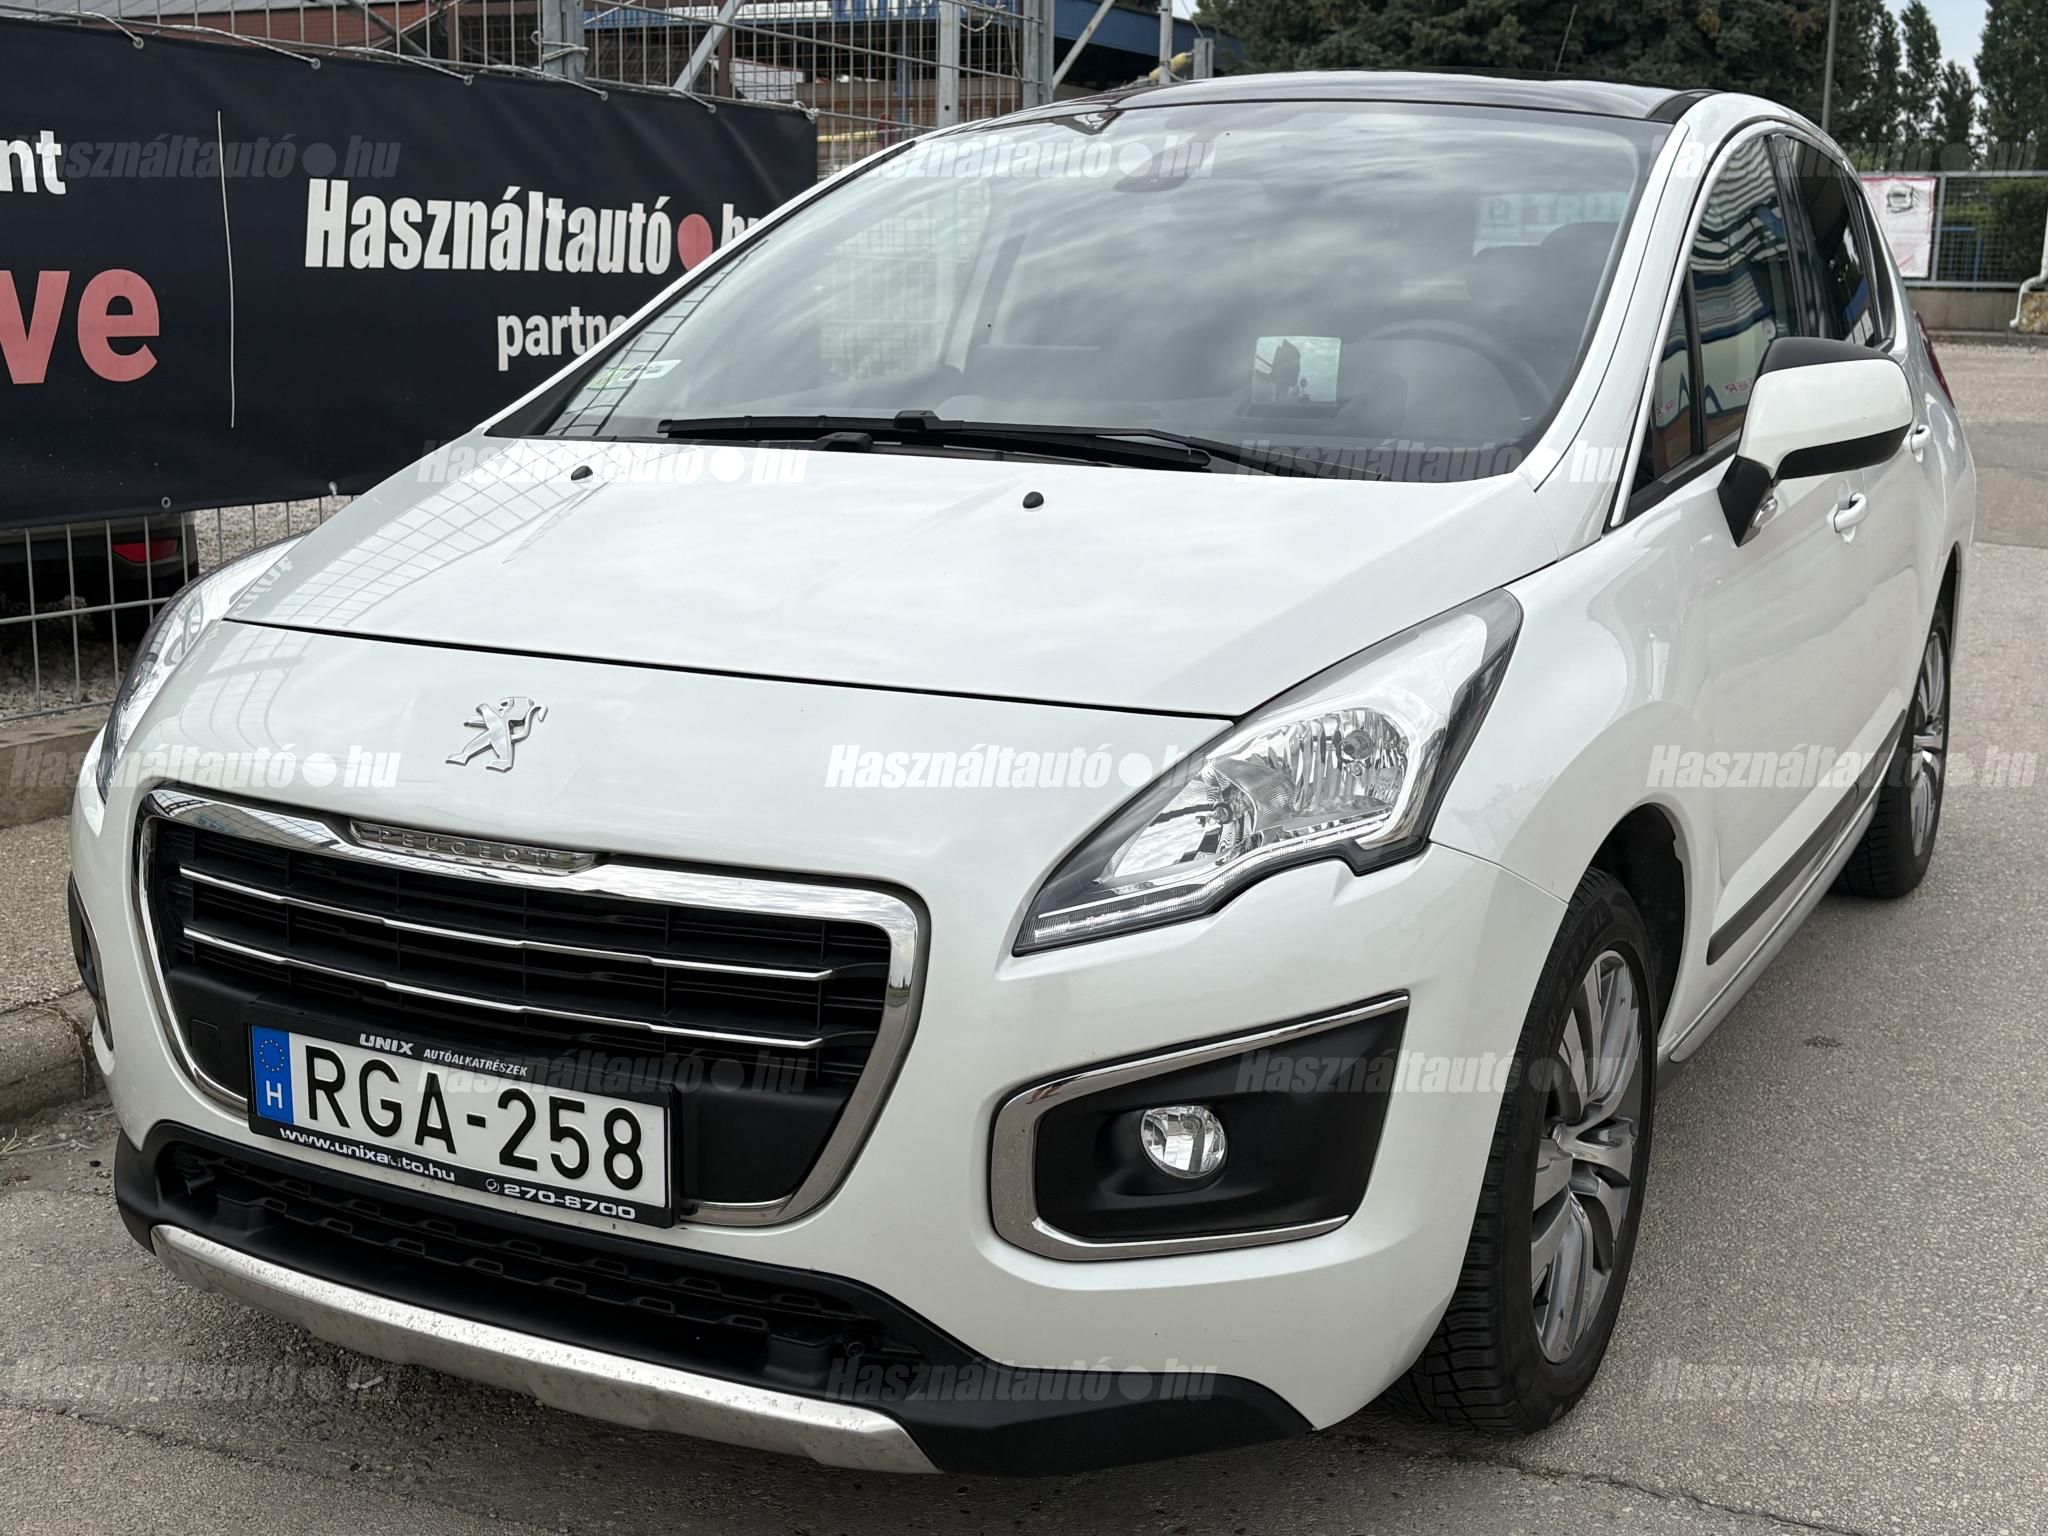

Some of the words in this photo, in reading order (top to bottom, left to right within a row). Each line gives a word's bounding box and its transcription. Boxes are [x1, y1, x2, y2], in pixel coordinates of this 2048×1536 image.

[377, 828, 550, 866] PEUGEOT
[359, 1033, 414, 1056] UNIX
[424, 1048, 528, 1077] AUTÓALKATRÉSZEK
[265, 1079, 283, 1109] H
[305, 1044, 643, 1191] RGA-258
[503, 1183, 636, 1220] 270-8700
